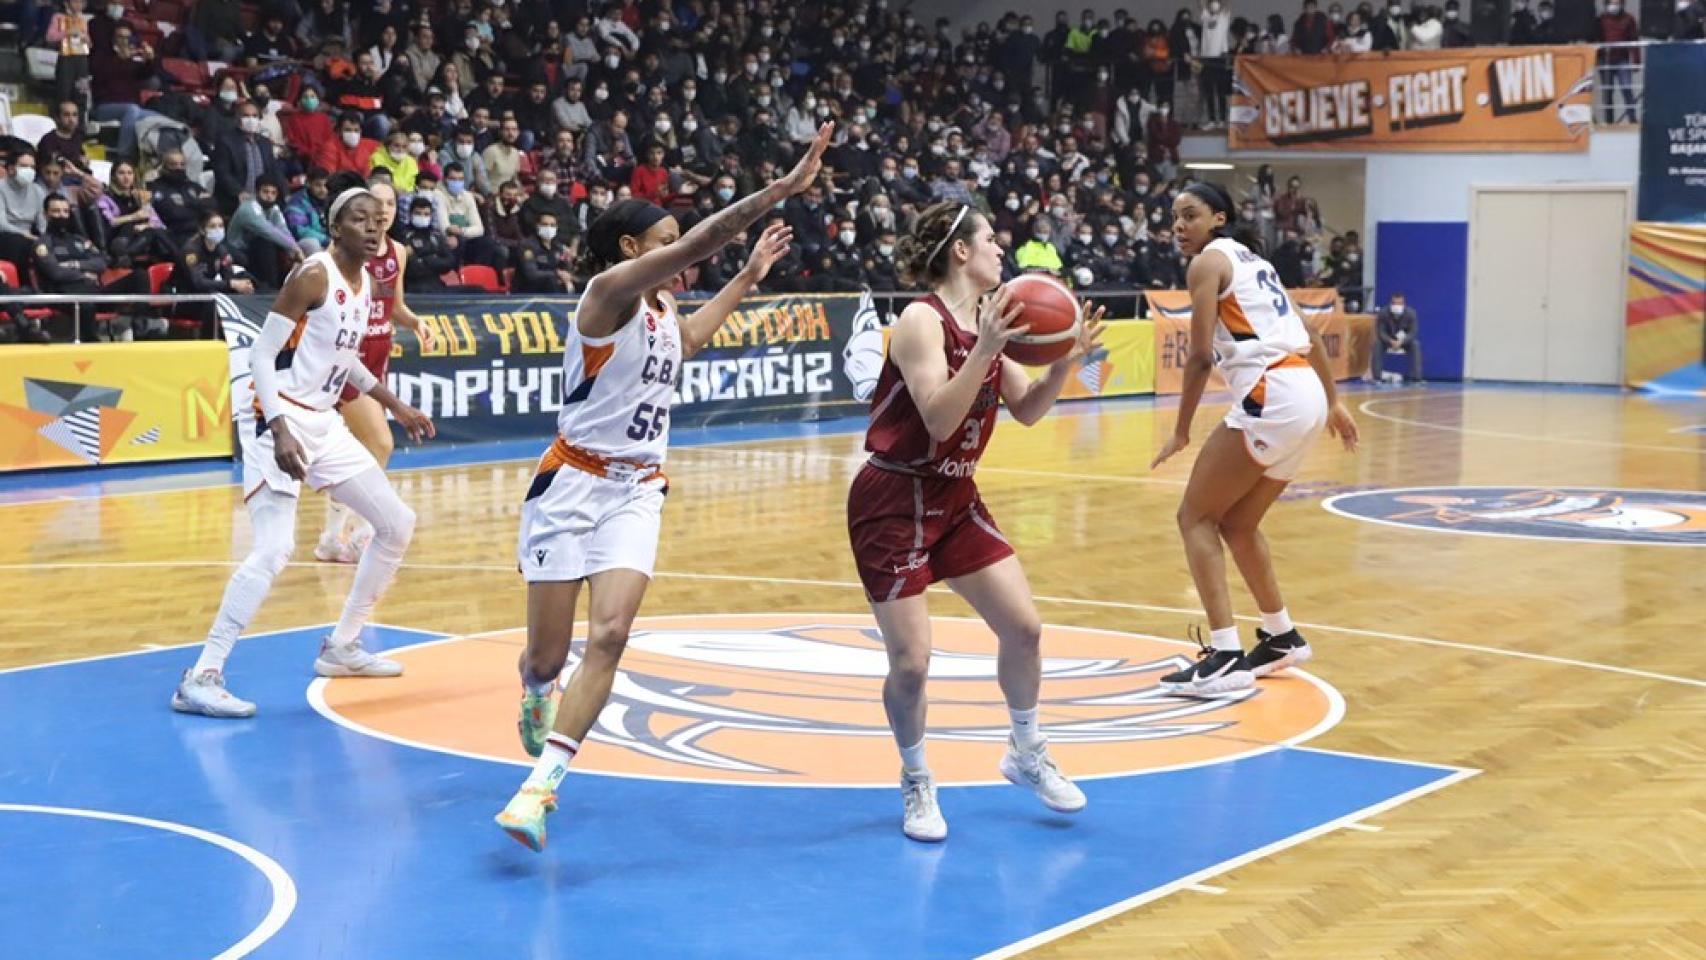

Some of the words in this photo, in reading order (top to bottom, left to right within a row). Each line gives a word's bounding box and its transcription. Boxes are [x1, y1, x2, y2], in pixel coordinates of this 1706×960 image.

[1264, 81, 1370, 135] BELIEVE
[1389, 66, 1467, 122] FIGHT
[1495, 52, 1555, 107] WIN
[414, 314, 477, 357] BU
[321, 364, 349, 395] 14
[671, 347, 833, 405] ACAĞIZ
[627, 402, 667, 441] 55
